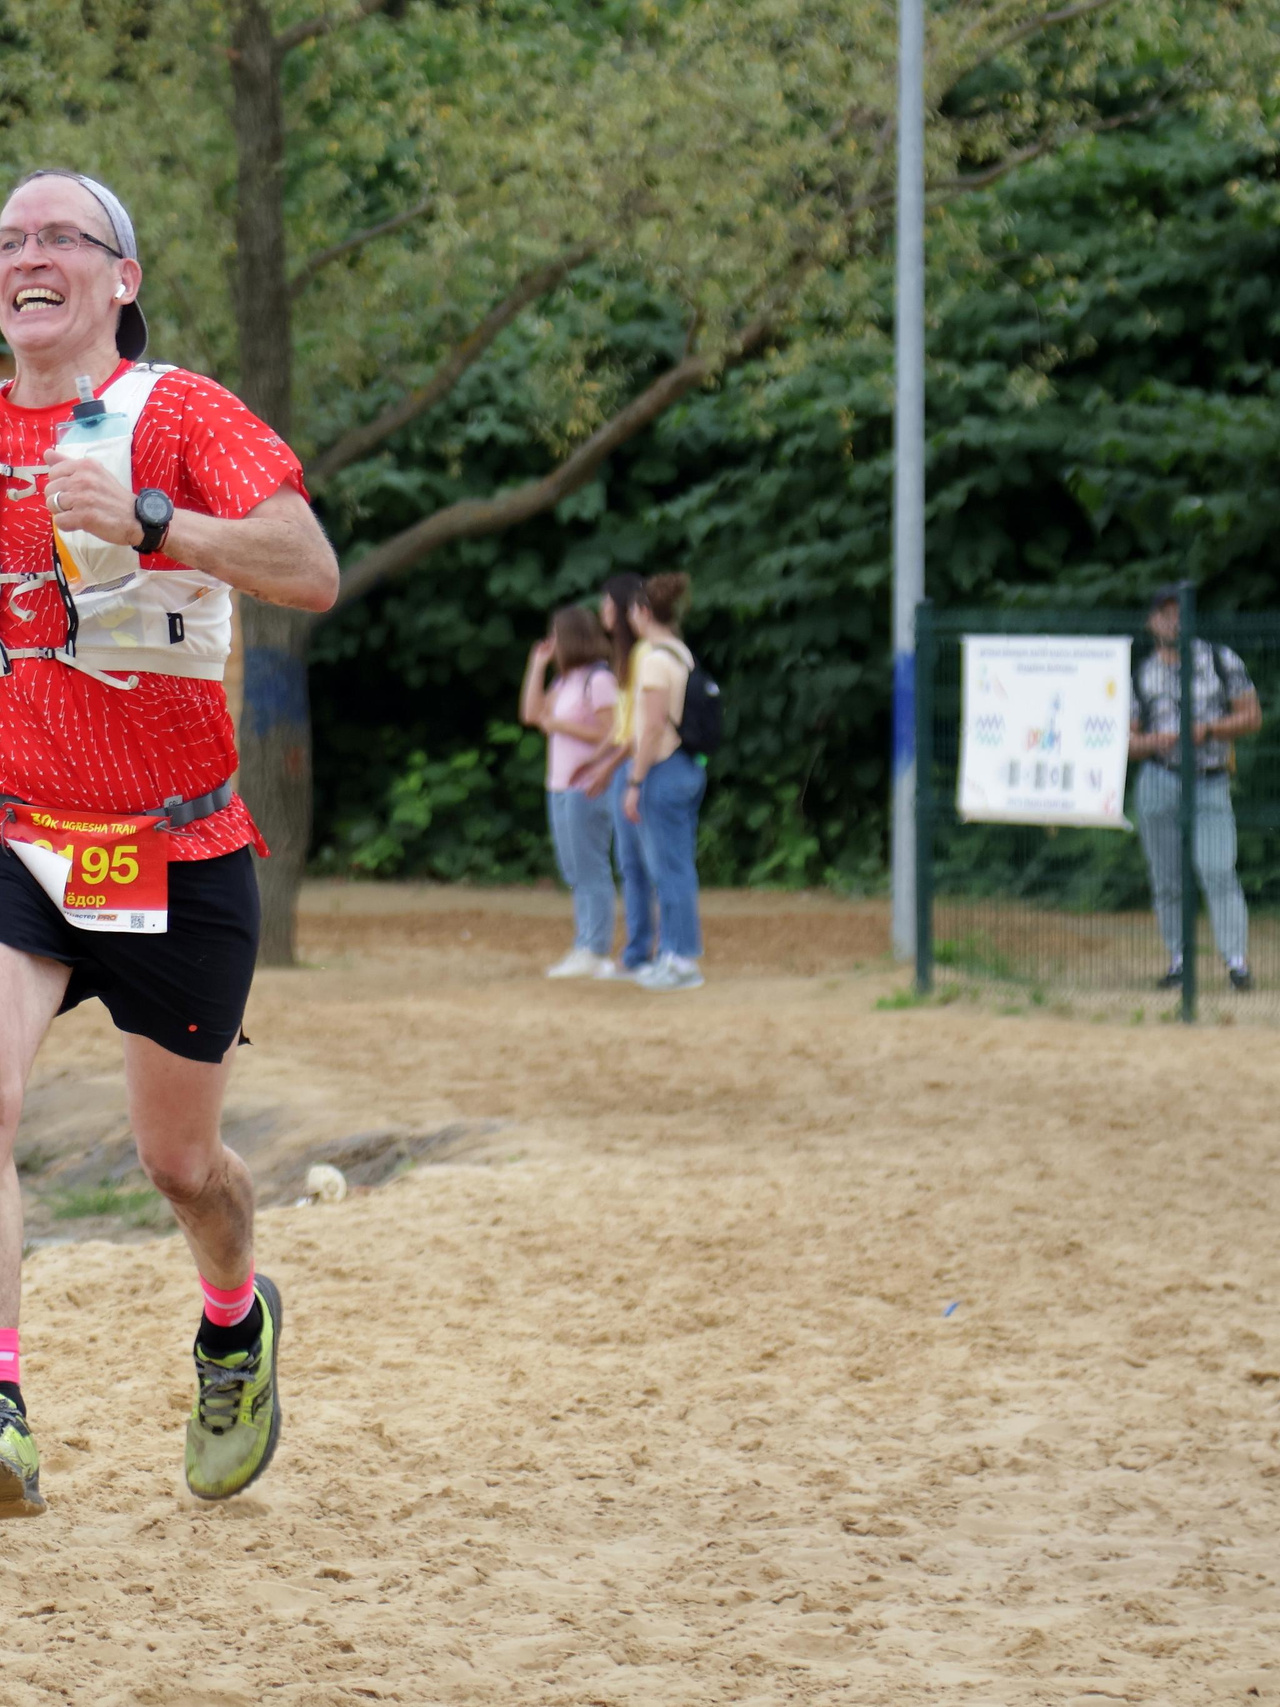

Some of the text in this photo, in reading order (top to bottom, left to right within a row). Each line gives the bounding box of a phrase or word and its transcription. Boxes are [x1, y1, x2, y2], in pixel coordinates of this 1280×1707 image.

[31, 813, 60, 830] 30K
[62, 821, 108, 834] UGRESHA
[64, 892, 106, 908] ёдор
